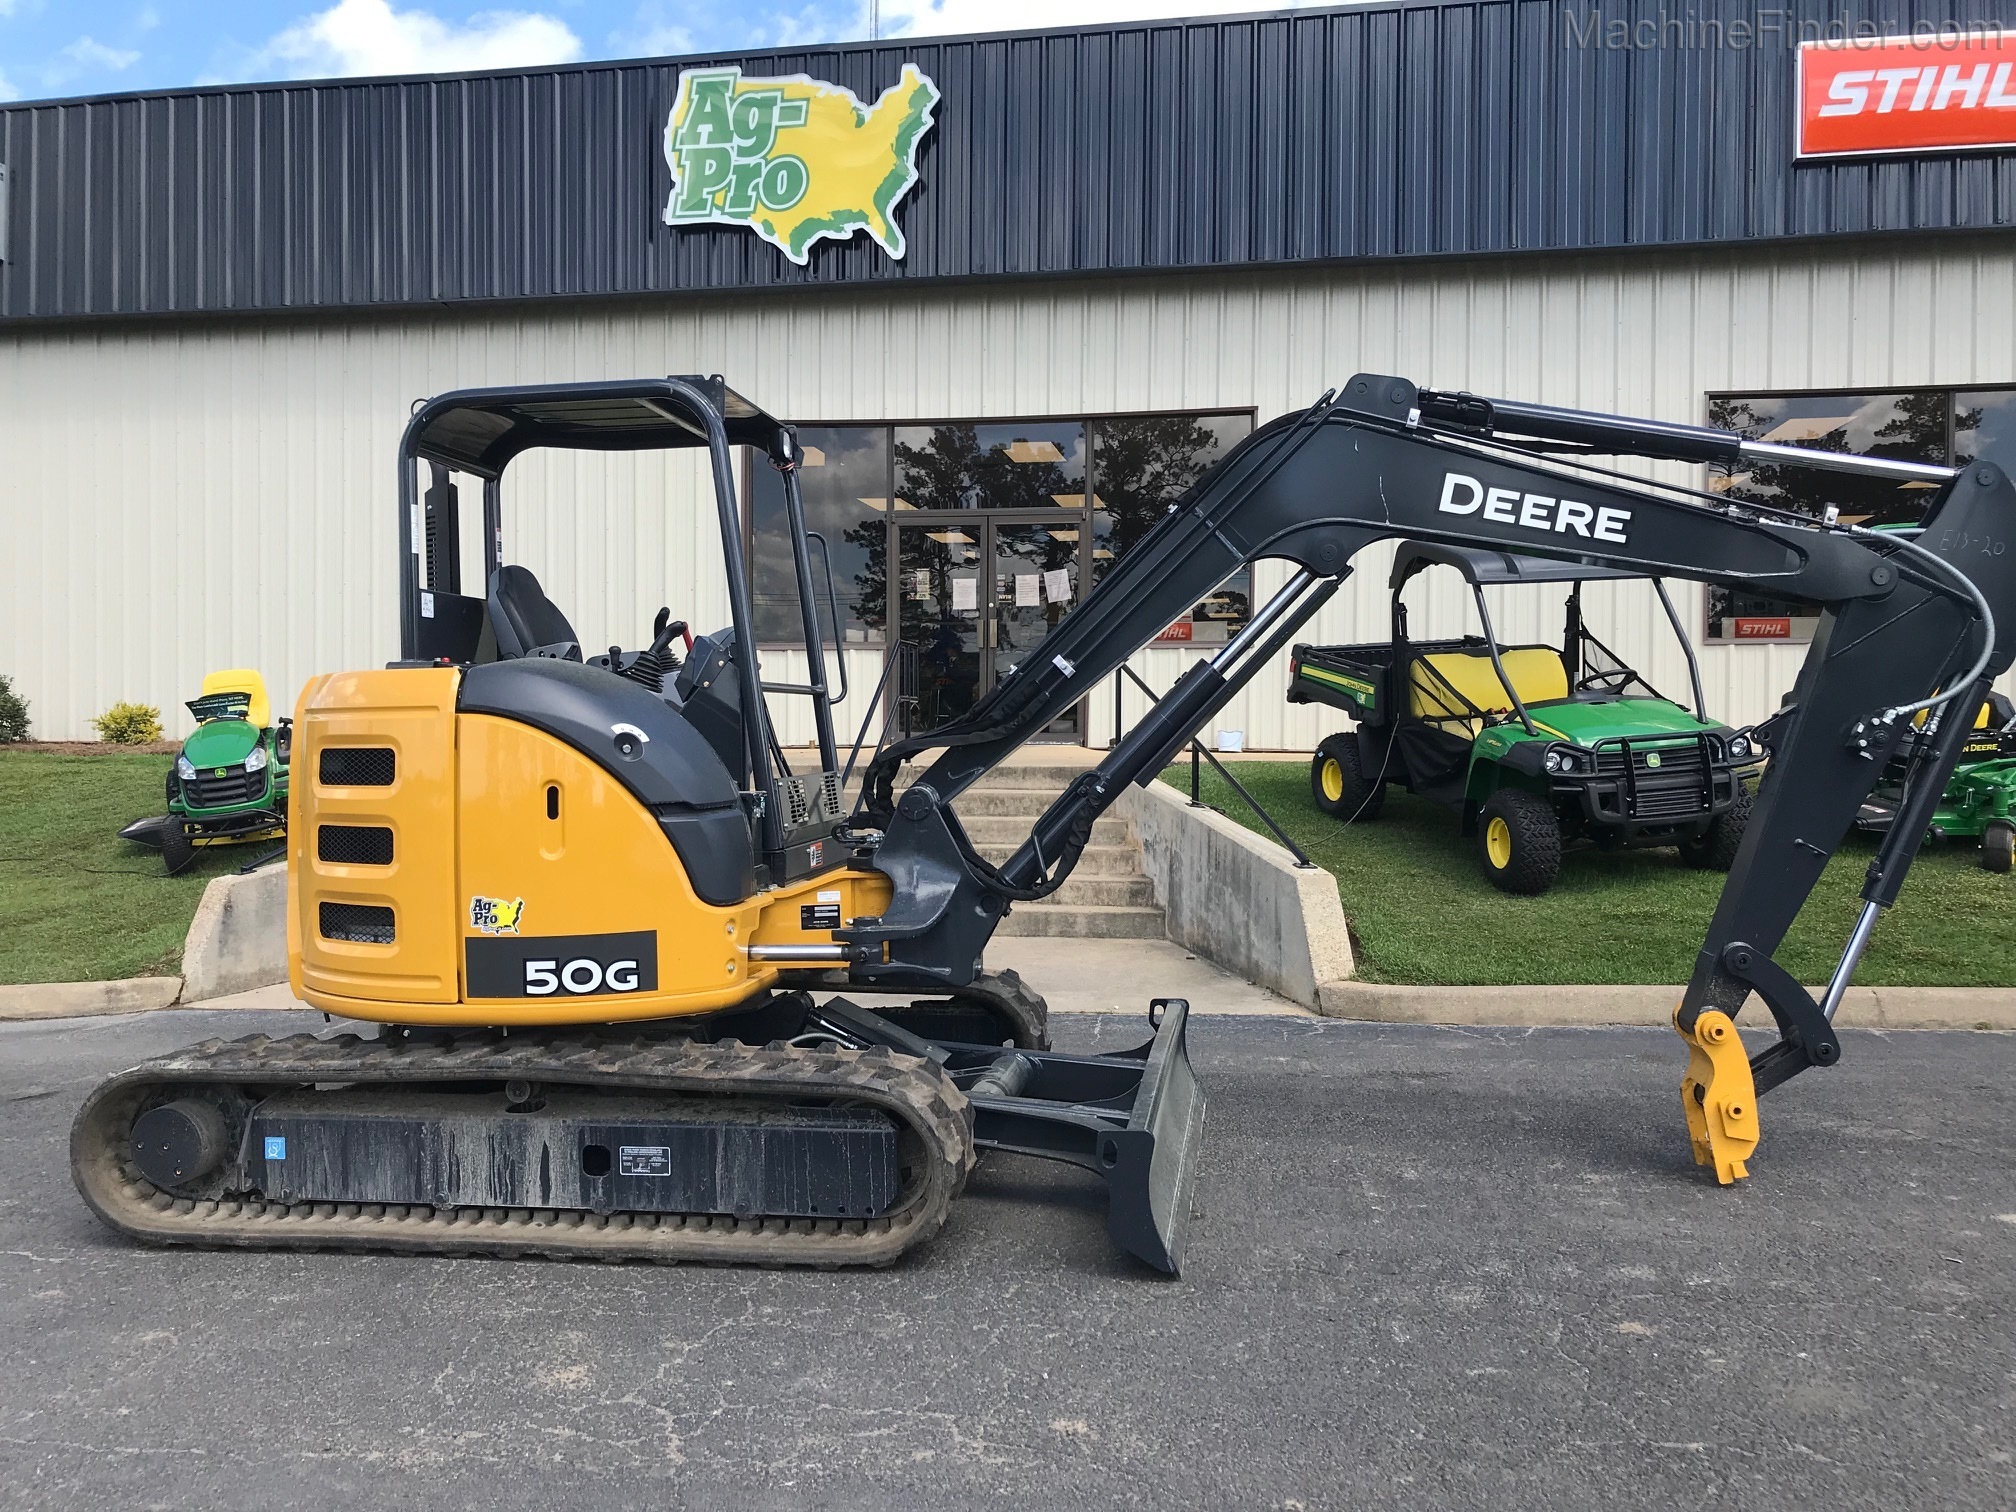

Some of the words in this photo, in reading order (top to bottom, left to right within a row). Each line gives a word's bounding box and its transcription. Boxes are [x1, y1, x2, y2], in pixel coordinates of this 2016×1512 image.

[1818, 62, 2016, 117] STIHL
[675, 74, 809, 158] Ag-
[673, 147, 808, 217] Pro
[1438, 472, 1632, 544] DEERE
[1740, 624, 1786, 635] STIHL
[1970, 743, 1998, 752] DEERE
[472, 898, 498, 914] Ag-
[473, 912, 498, 925] Pro
[525, 958, 640, 994] 50G
